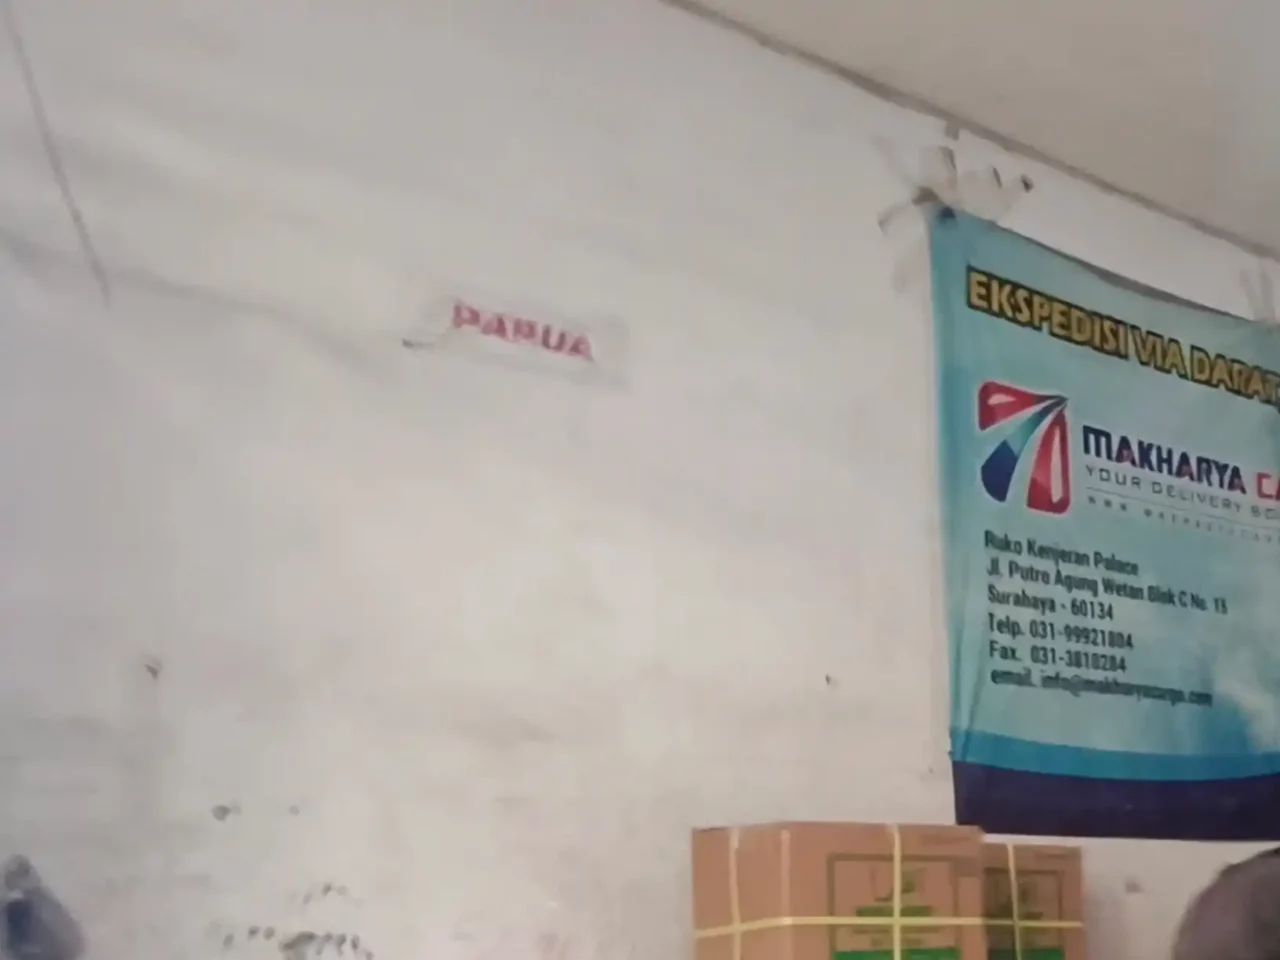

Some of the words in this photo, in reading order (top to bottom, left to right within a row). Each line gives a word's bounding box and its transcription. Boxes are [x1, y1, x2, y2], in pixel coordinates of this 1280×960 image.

[453, 300, 595, 361] PAPUA
[968, 266, 1128, 361] EKSPEDISI
[1129, 326, 1189, 380] VIA
[1083, 425, 1247, 494] MAKHARYA
[1085, 464, 1142, 489] YOUR
[1151, 481, 1242, 513] DELIVERY
[984, 529, 1023, 555] Ruko
[1026, 537, 1090, 568] Kenjeran
[1093, 550, 1140, 576] Palace
[987, 557, 1003, 578] Jl.
[1054, 567, 1099, 597] Agung
[1102, 576, 1145, 601] Wetan
[1147, 584, 1177, 607] Blok
[1178, 590, 1188, 608] C
[987, 584, 1056, 616] Surabaya
[1070, 600, 1114, 621] 60134
[988, 613, 1024, 639] Telp.
[989, 640, 1022, 662] Fax.
